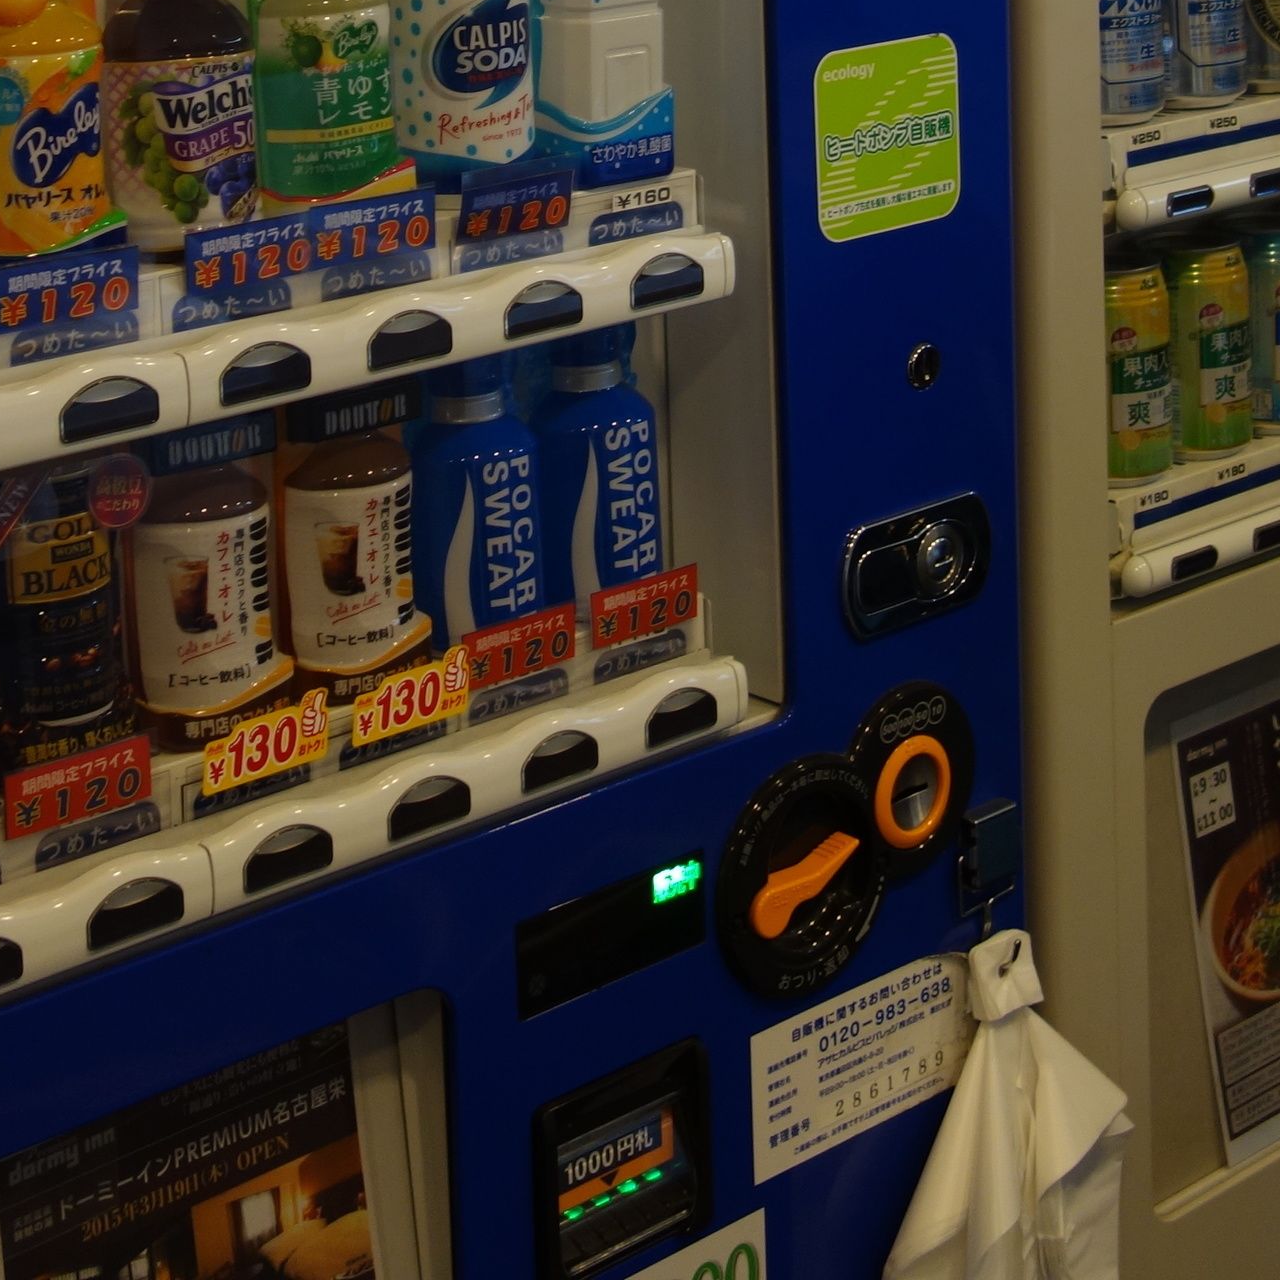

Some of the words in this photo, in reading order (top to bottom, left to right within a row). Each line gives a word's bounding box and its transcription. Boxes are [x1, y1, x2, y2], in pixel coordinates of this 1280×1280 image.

[453, 18, 527, 51] CALPIS
[455, 44, 528, 74] SODA
[823, 61, 876, 82] ecology
[174, 126, 231, 158] GRAPE
[1131, 129, 1162, 146] ¥250
[1209, 115, 1238, 129] ¥250
[5, 187, 74, 209] バヤリース
[464, 194, 570, 239] ¥120
[617, 187, 671, 209] ¥160
[315, 214, 431, 261] ¥120
[193, 237, 313, 289] ¥120
[1217, 463, 1246, 480] ¥180
[604, 426, 639, 573] SWEAT
[1139, 489, 1170, 507] ¥180
[481, 461, 518, 615] SWEAT
[22, 553, 109, 597] BLACK
[596, 589, 693, 639] ¥120
[470, 630, 570, 682] ¥120
[357, 670, 441, 738] ¥130
[207, 714, 298, 787] ¥130
[14, 765, 143, 828] ¥120
[791, 962, 943, 1043] 自販機に関するお問い合わせは
[819, 976, 952, 1052] 0120-983-638
[236, 1130, 291, 1171] OPEN
[564, 1125, 654, 1185] 1000円札
